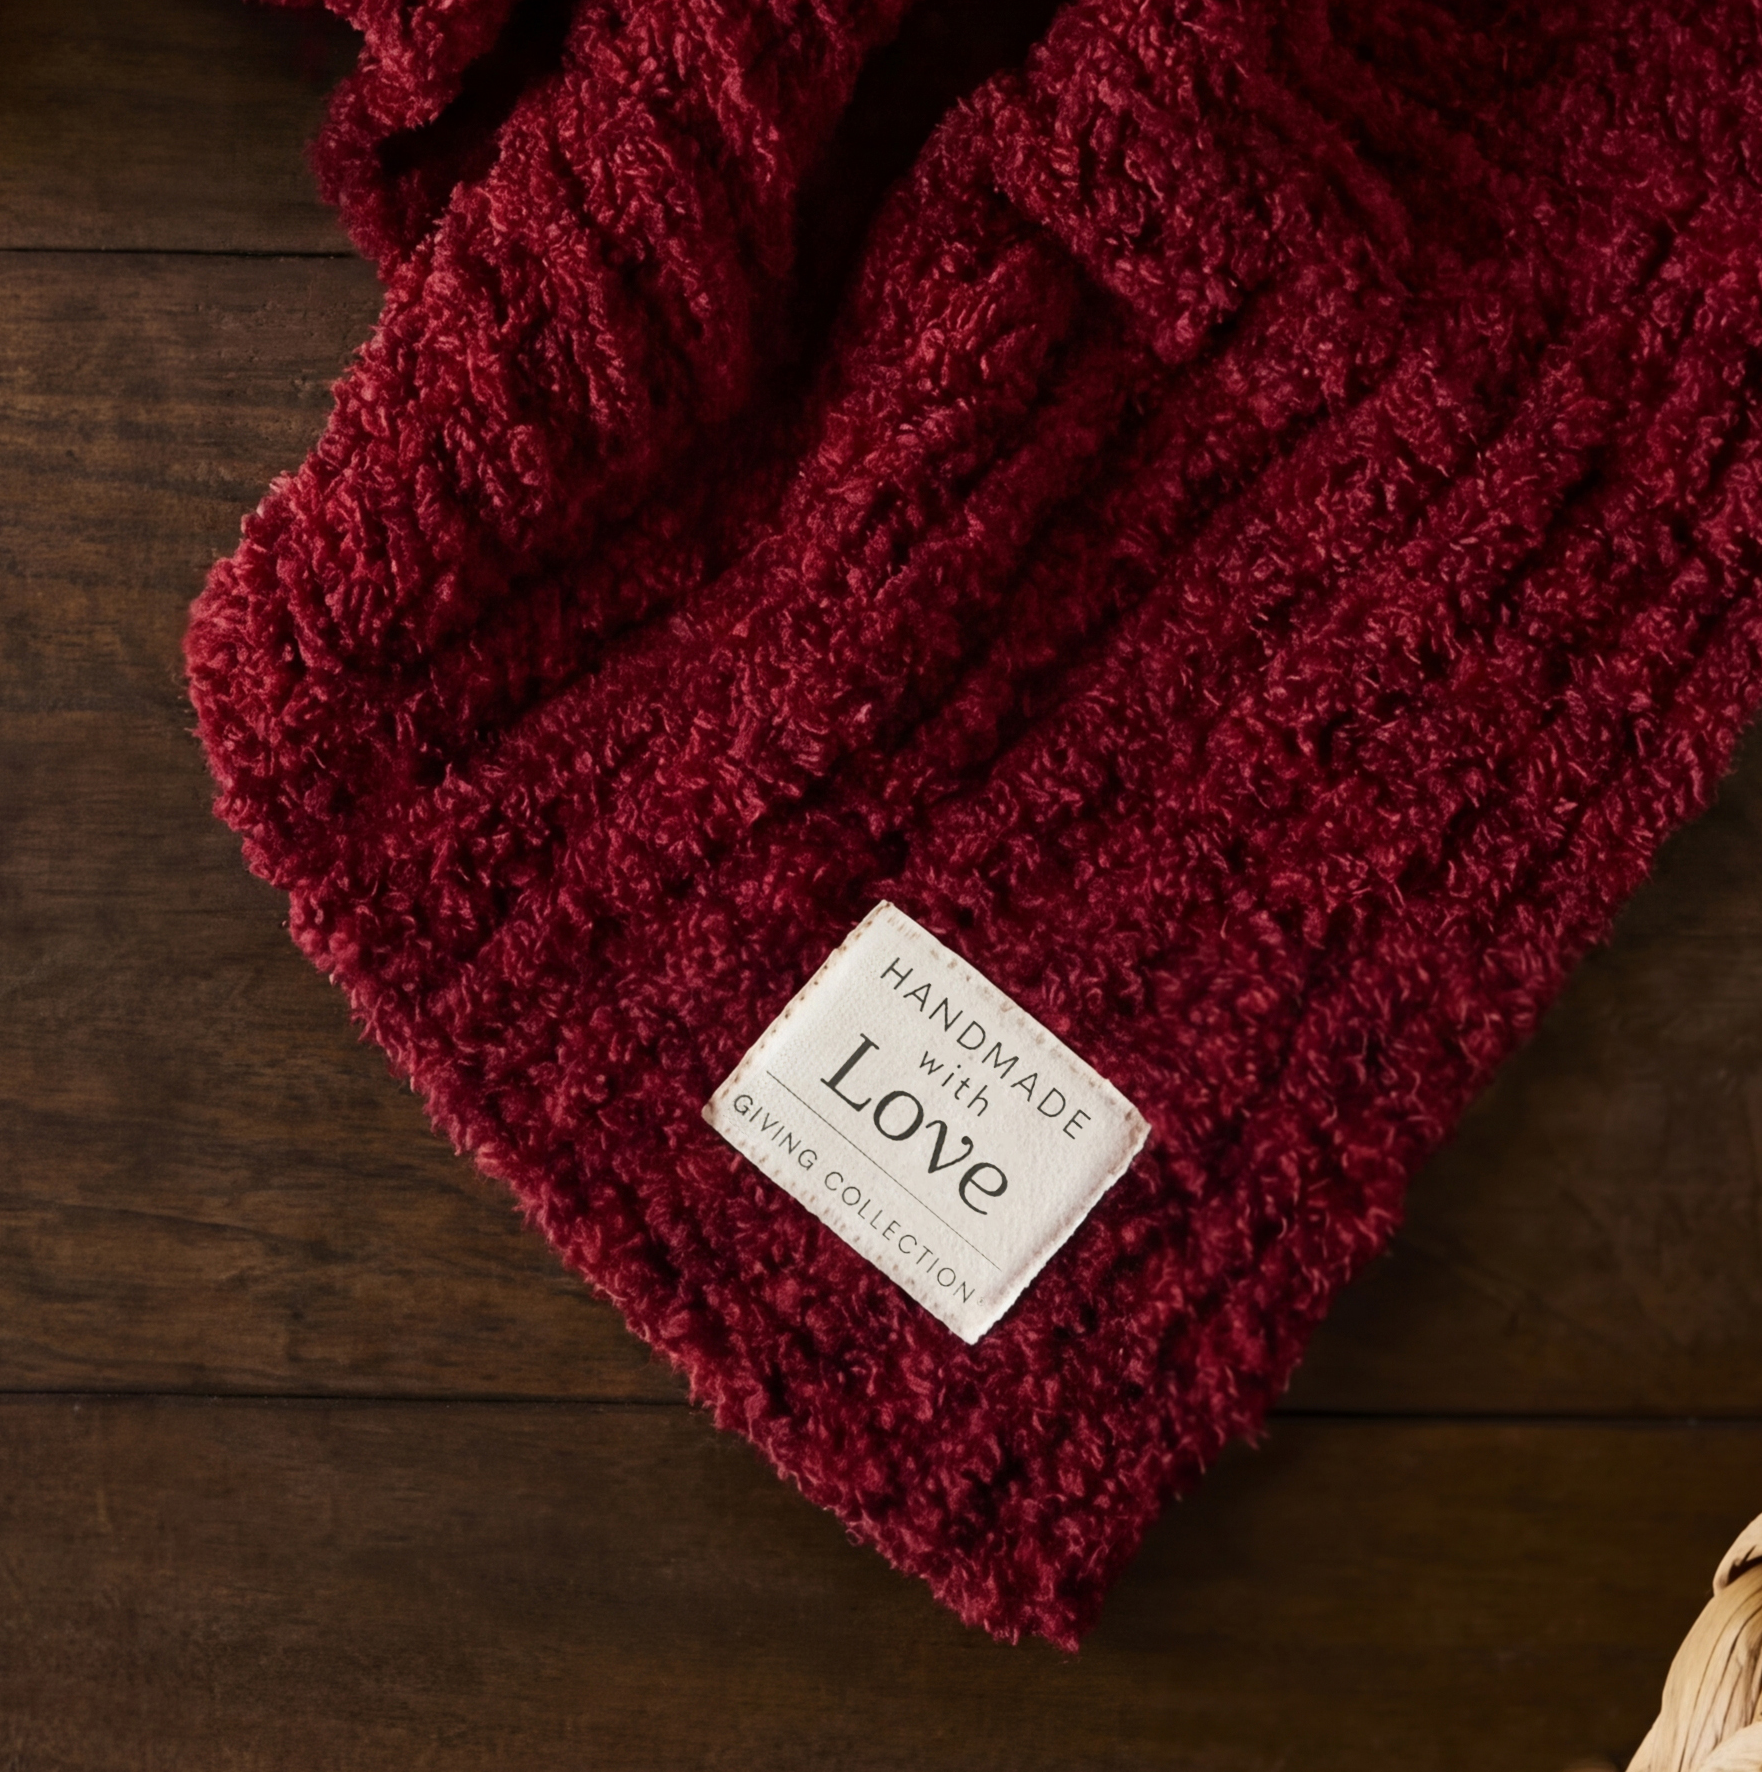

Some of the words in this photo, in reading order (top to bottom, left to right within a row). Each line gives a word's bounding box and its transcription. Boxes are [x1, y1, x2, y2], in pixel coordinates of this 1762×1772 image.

[820, 1032, 1009, 1216] Love
[879, 957, 1092, 1140] HANDMADE
[918, 1050, 989, 1117] with
[733, 1093, 818, 1171] GIVING
[823, 1170, 976, 1303] COLLECTION
